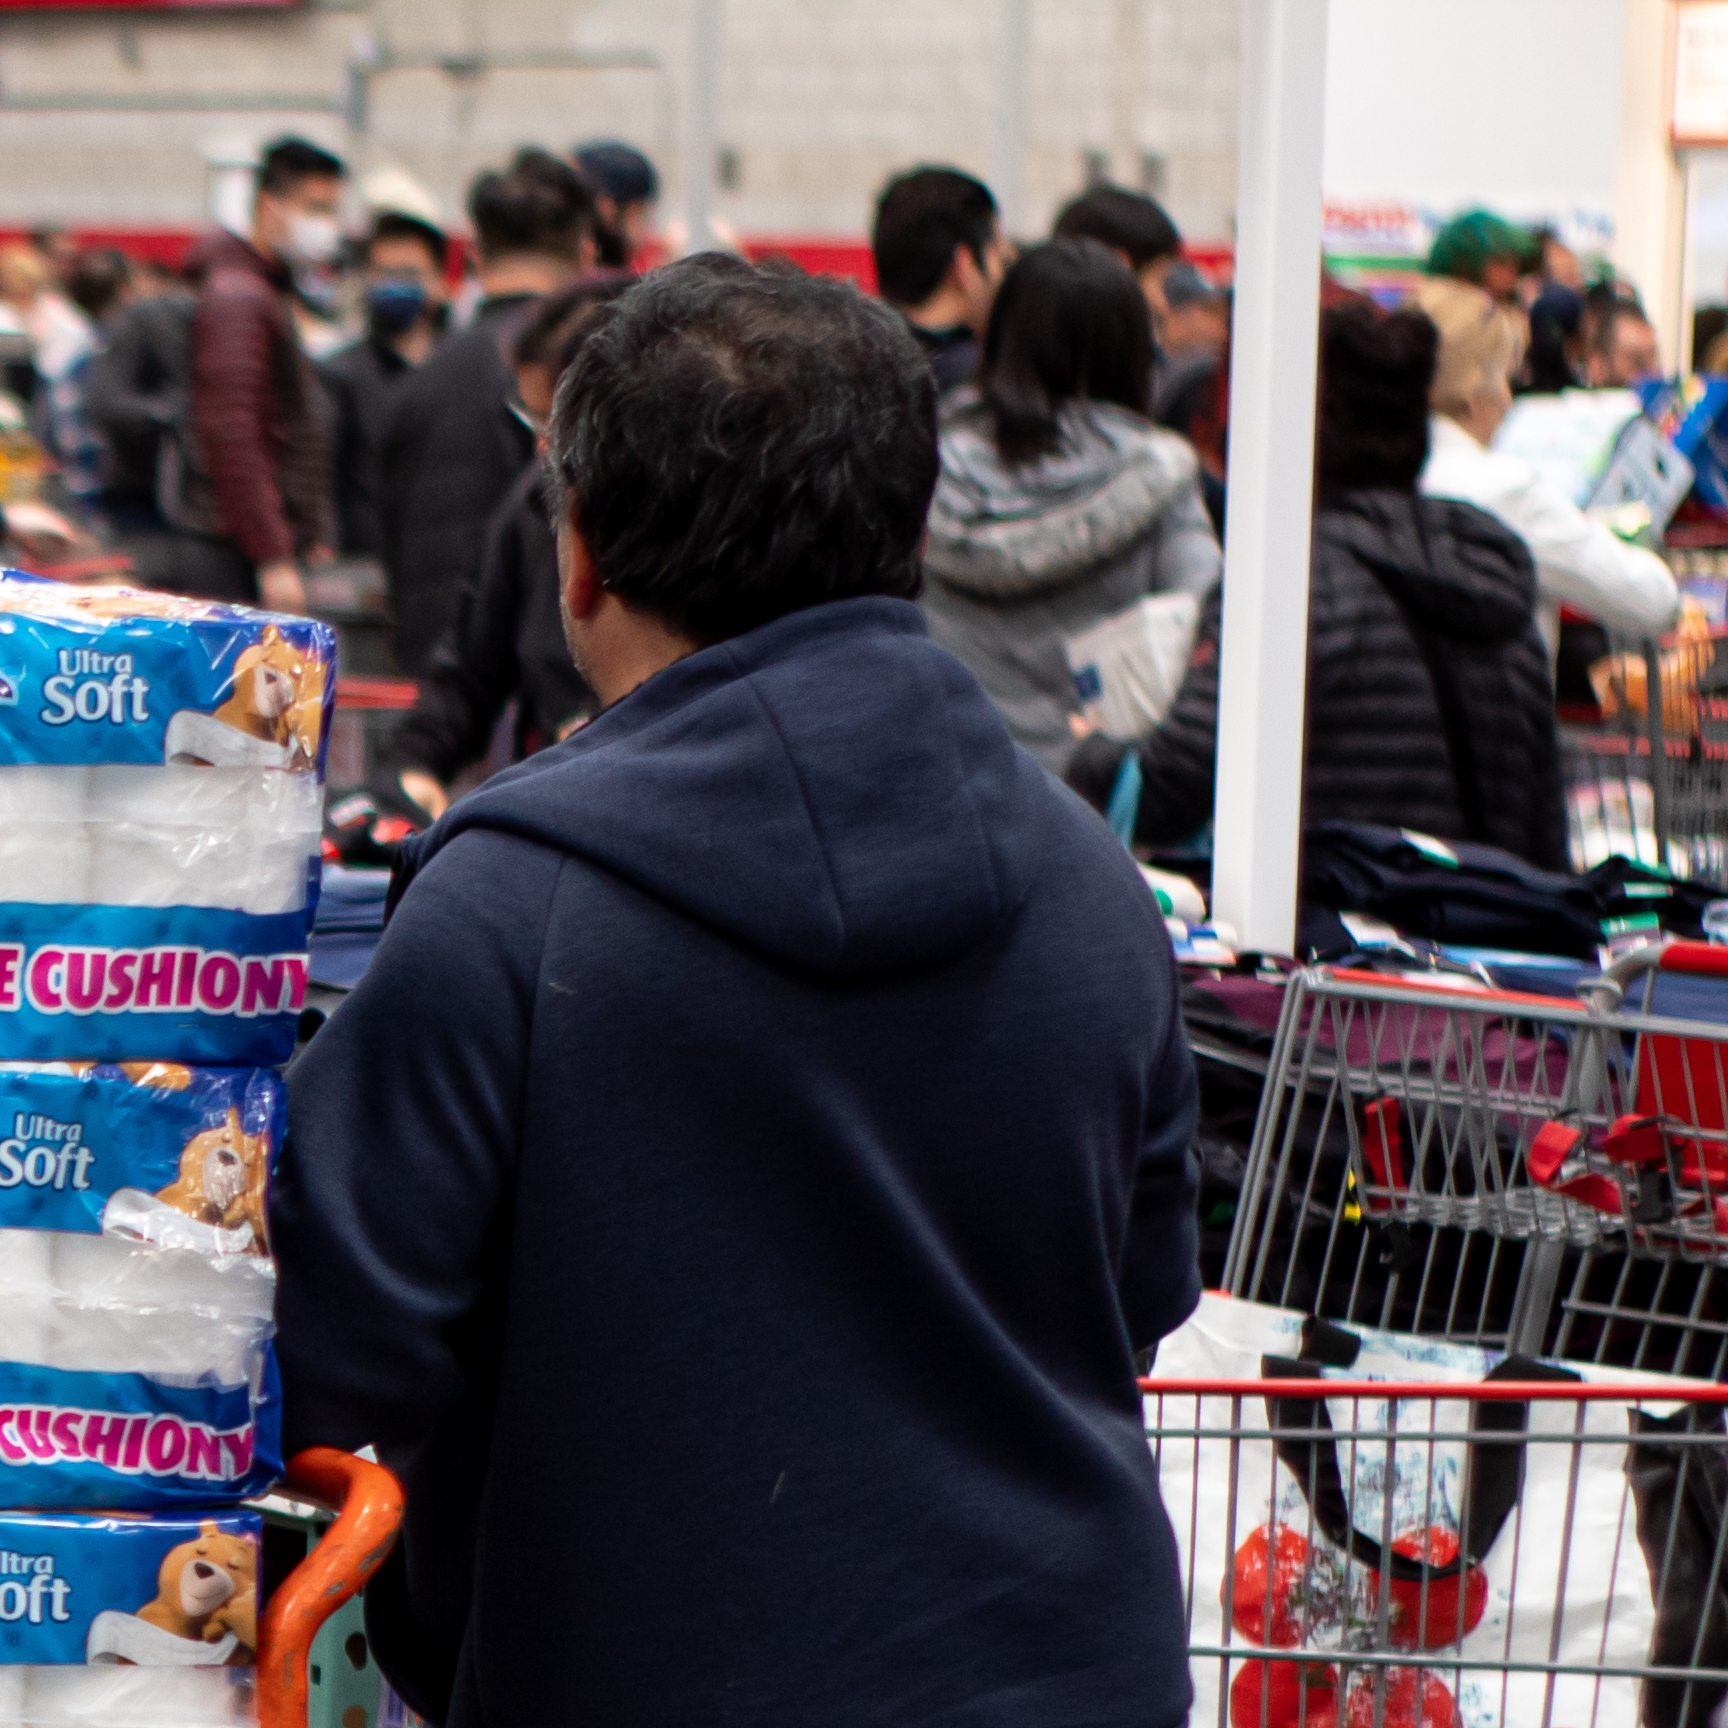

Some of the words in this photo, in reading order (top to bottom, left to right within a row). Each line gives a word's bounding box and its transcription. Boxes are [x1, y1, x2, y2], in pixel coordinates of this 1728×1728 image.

[58, 649, 132, 677] Ultra
[42, 676, 150, 726] Soft
[15, 1113, 83, 1143] Ultra
